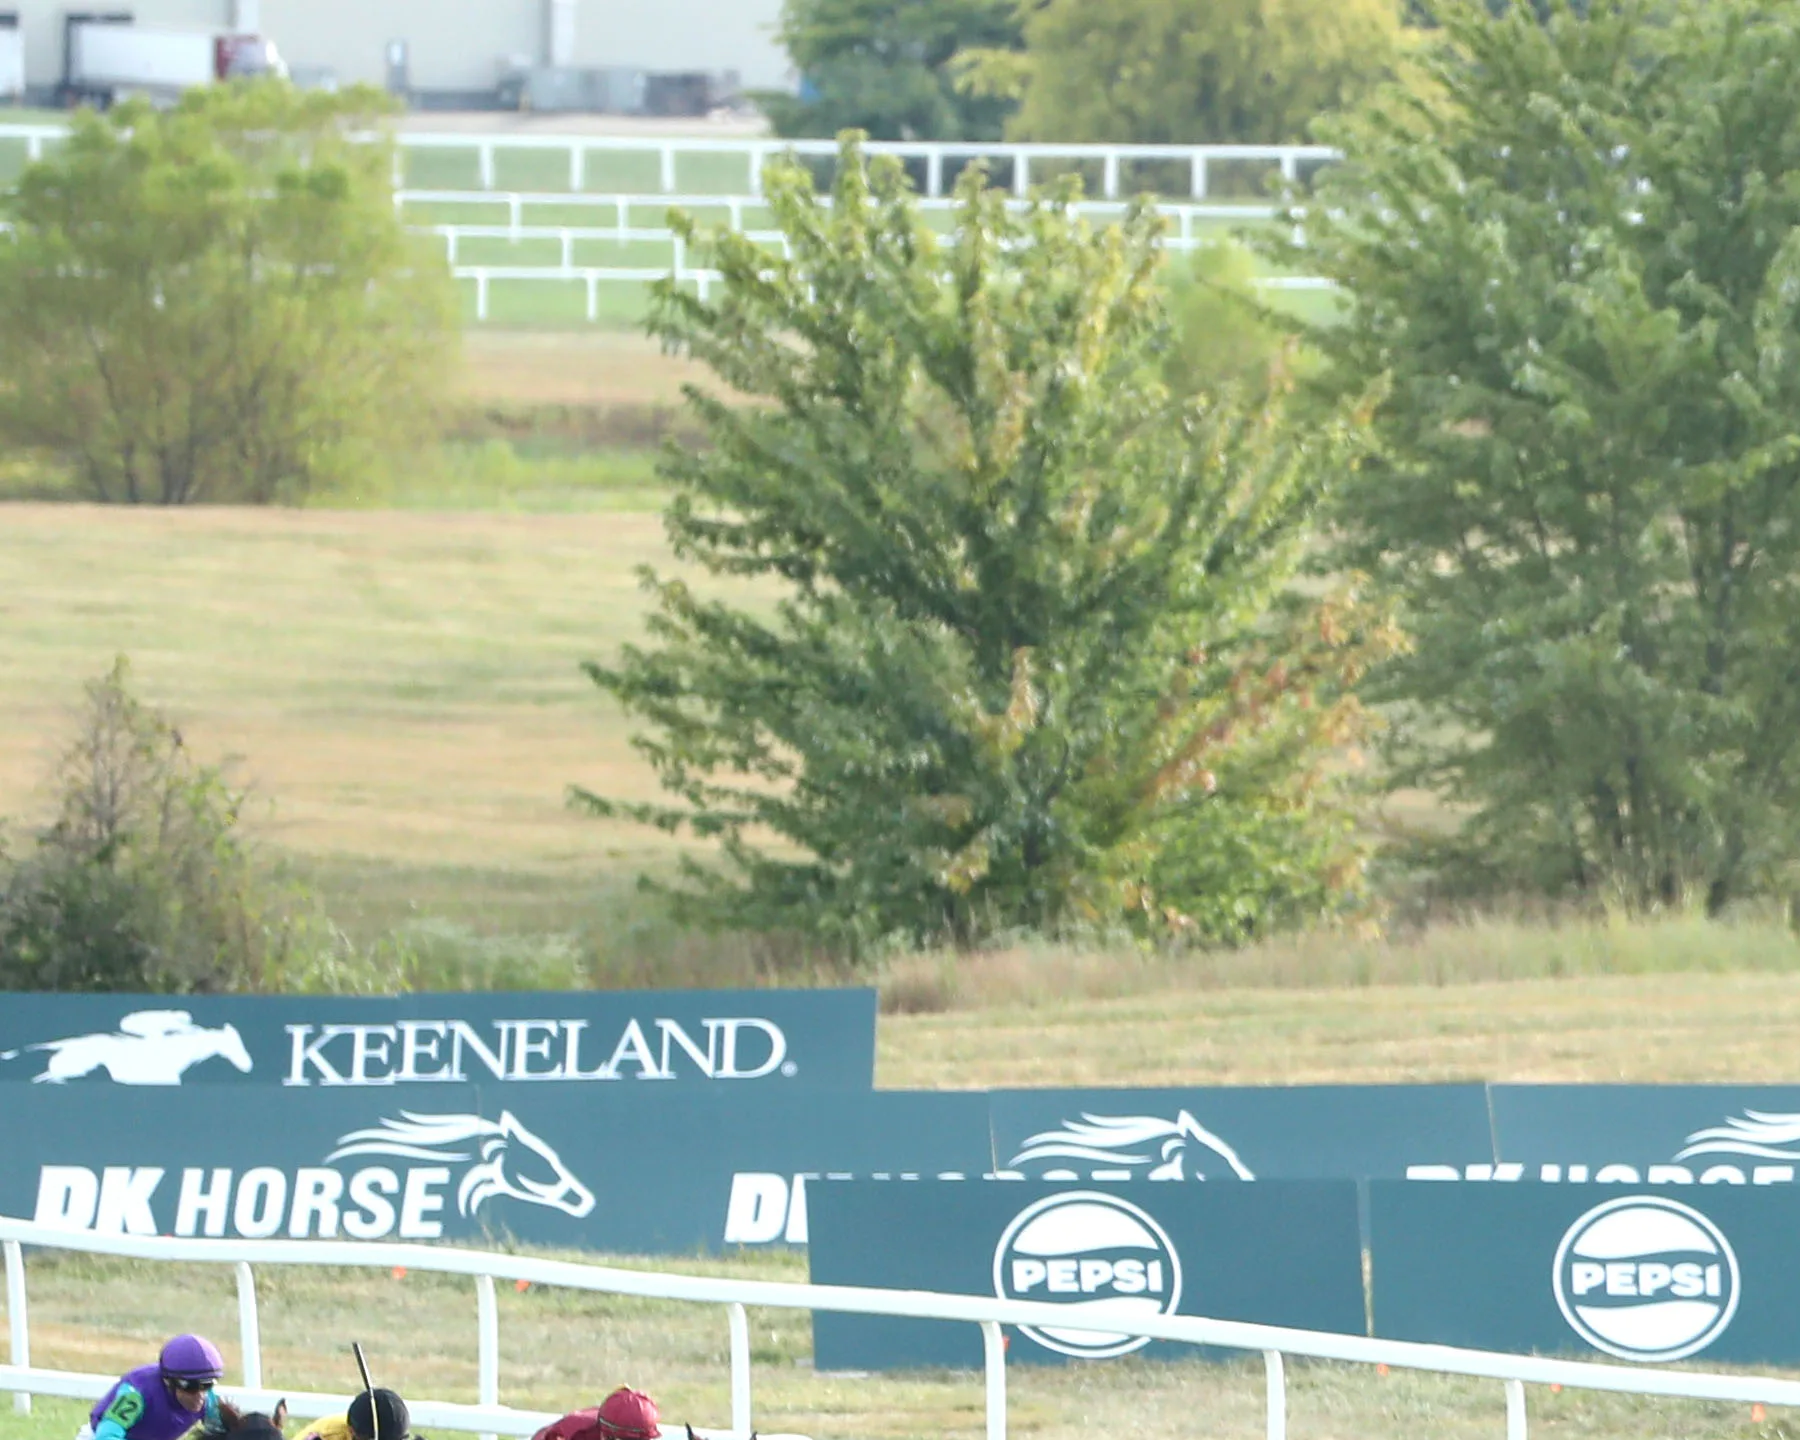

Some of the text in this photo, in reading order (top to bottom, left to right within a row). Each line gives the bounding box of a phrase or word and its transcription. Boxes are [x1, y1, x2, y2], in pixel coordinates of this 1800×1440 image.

[34, 1165, 450, 1239] DK HORSE
[1012, 1259, 1163, 1293] PEPSI
[1572, 1262, 1721, 1297] PEPSI
[111, 1395, 138, 1421] 12
